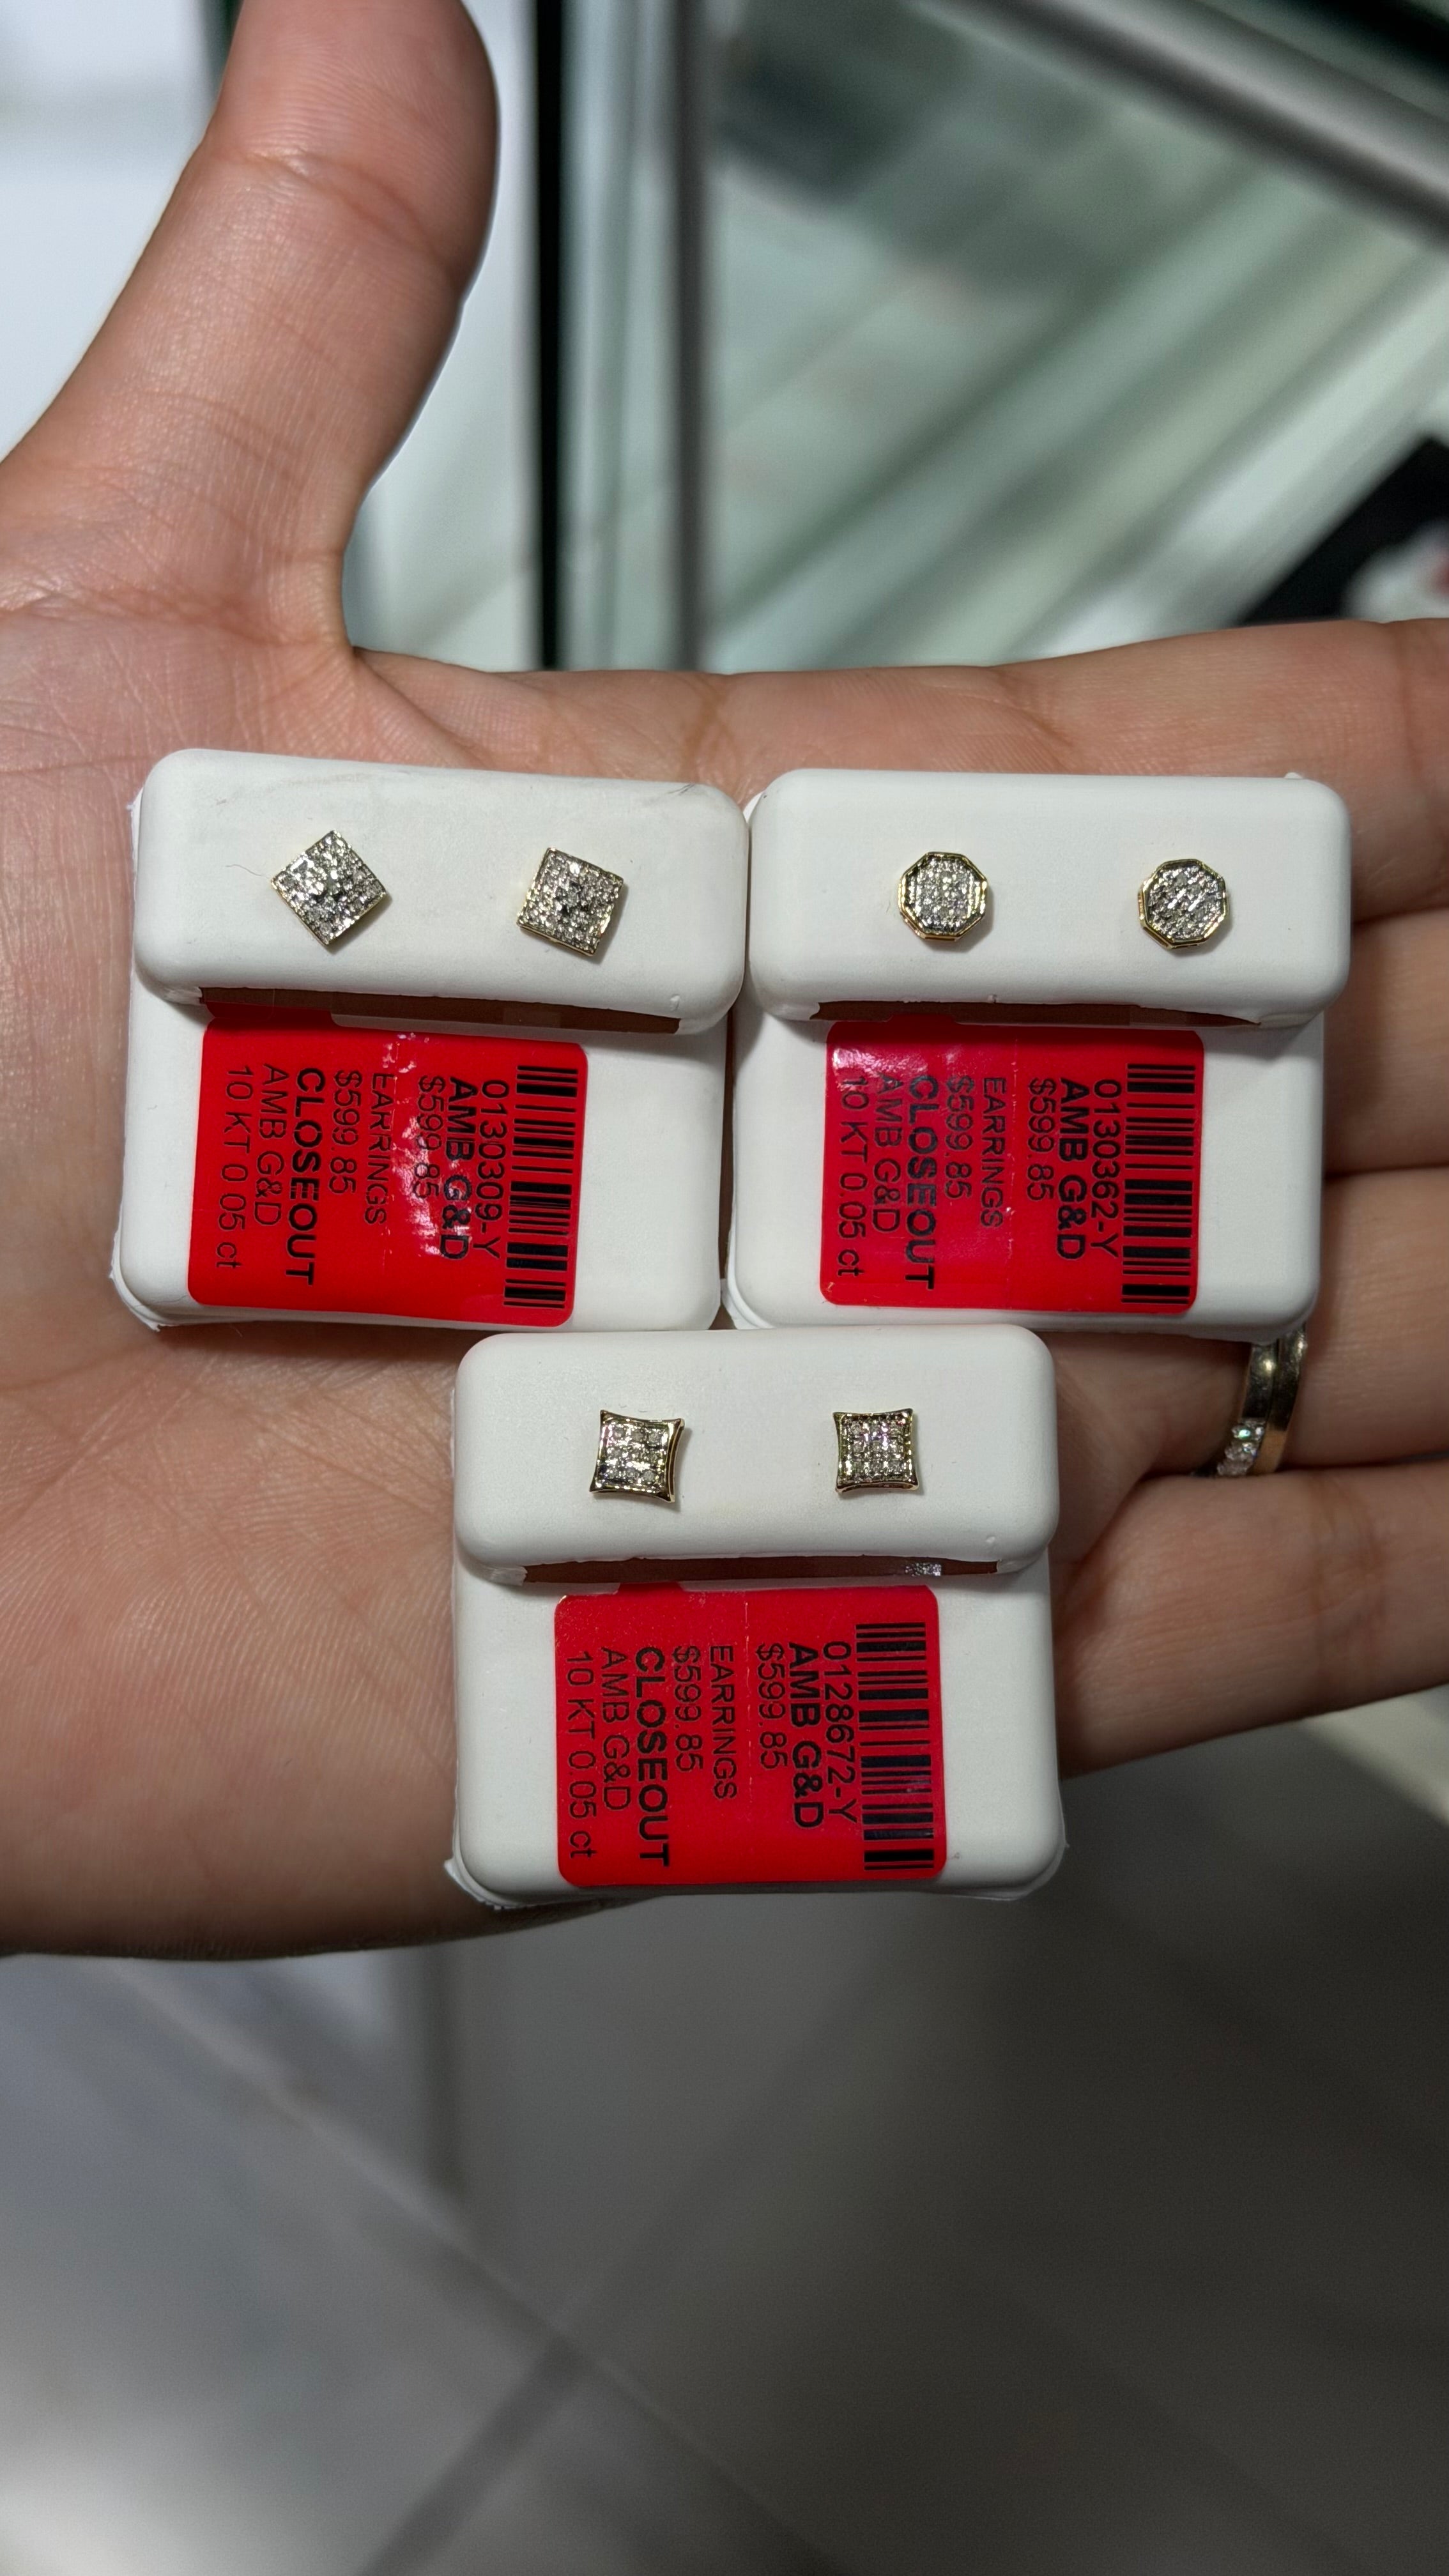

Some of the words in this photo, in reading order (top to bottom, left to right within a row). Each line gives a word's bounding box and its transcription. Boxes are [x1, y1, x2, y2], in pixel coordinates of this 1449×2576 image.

[226, 1065, 254, 1100] 10
[259, 1064, 289, 1140] AMB
[447, 1077, 477, 1162] AMB
[840, 1077, 870, 1111] 10
[874, 1073, 903, 1148] AMB
[1057, 1078, 1090, 1163] AMB
[223, 1111, 251, 1153] KT
[364, 1073, 395, 1225] EARRINGS
[470, 1080, 509, 1259] 0130309-Y
[839, 1122, 868, 1164] KT
[944, 1075, 975, 1200] $599.85
[980, 1077, 1007, 1227] EARRINGS
[1026, 1078, 1057, 1201] $599.85
[1090, 1078, 1122, 1257] 0130362-Y
[254, 1151, 285, 1225] G&D
[286, 1067, 325, 1285] CLOSEOUT
[438, 1174, 472, 1261] G&D
[838, 1172, 868, 1240] 0.05
[871, 1158, 901, 1233] G&D
[905, 1075, 939, 1290] CLOSEOUT
[1056, 1174, 1087, 1260] G&D
[216, 1241, 241, 1269] ct
[837, 1249, 864, 1277] ct
[566, 1650, 594, 1686] 10
[601, 1646, 630, 1723] AMB
[671, 1644, 703, 1773] $599.85
[755, 1642, 789, 1770] $599.85
[788, 1641, 822, 1728] AMB
[567, 1698, 596, 1740] KT
[635, 1646, 670, 1867] CLOSEOUT
[709, 1644, 738, 1800] EARRINGS
[822, 1640, 858, 1824] 0128672-Y
[567, 1750, 597, 1821] 0.05
[602, 1735, 632, 1811] G&D
[791, 1740, 825, 1828] G&D
[569, 1831, 597, 1859] ct
